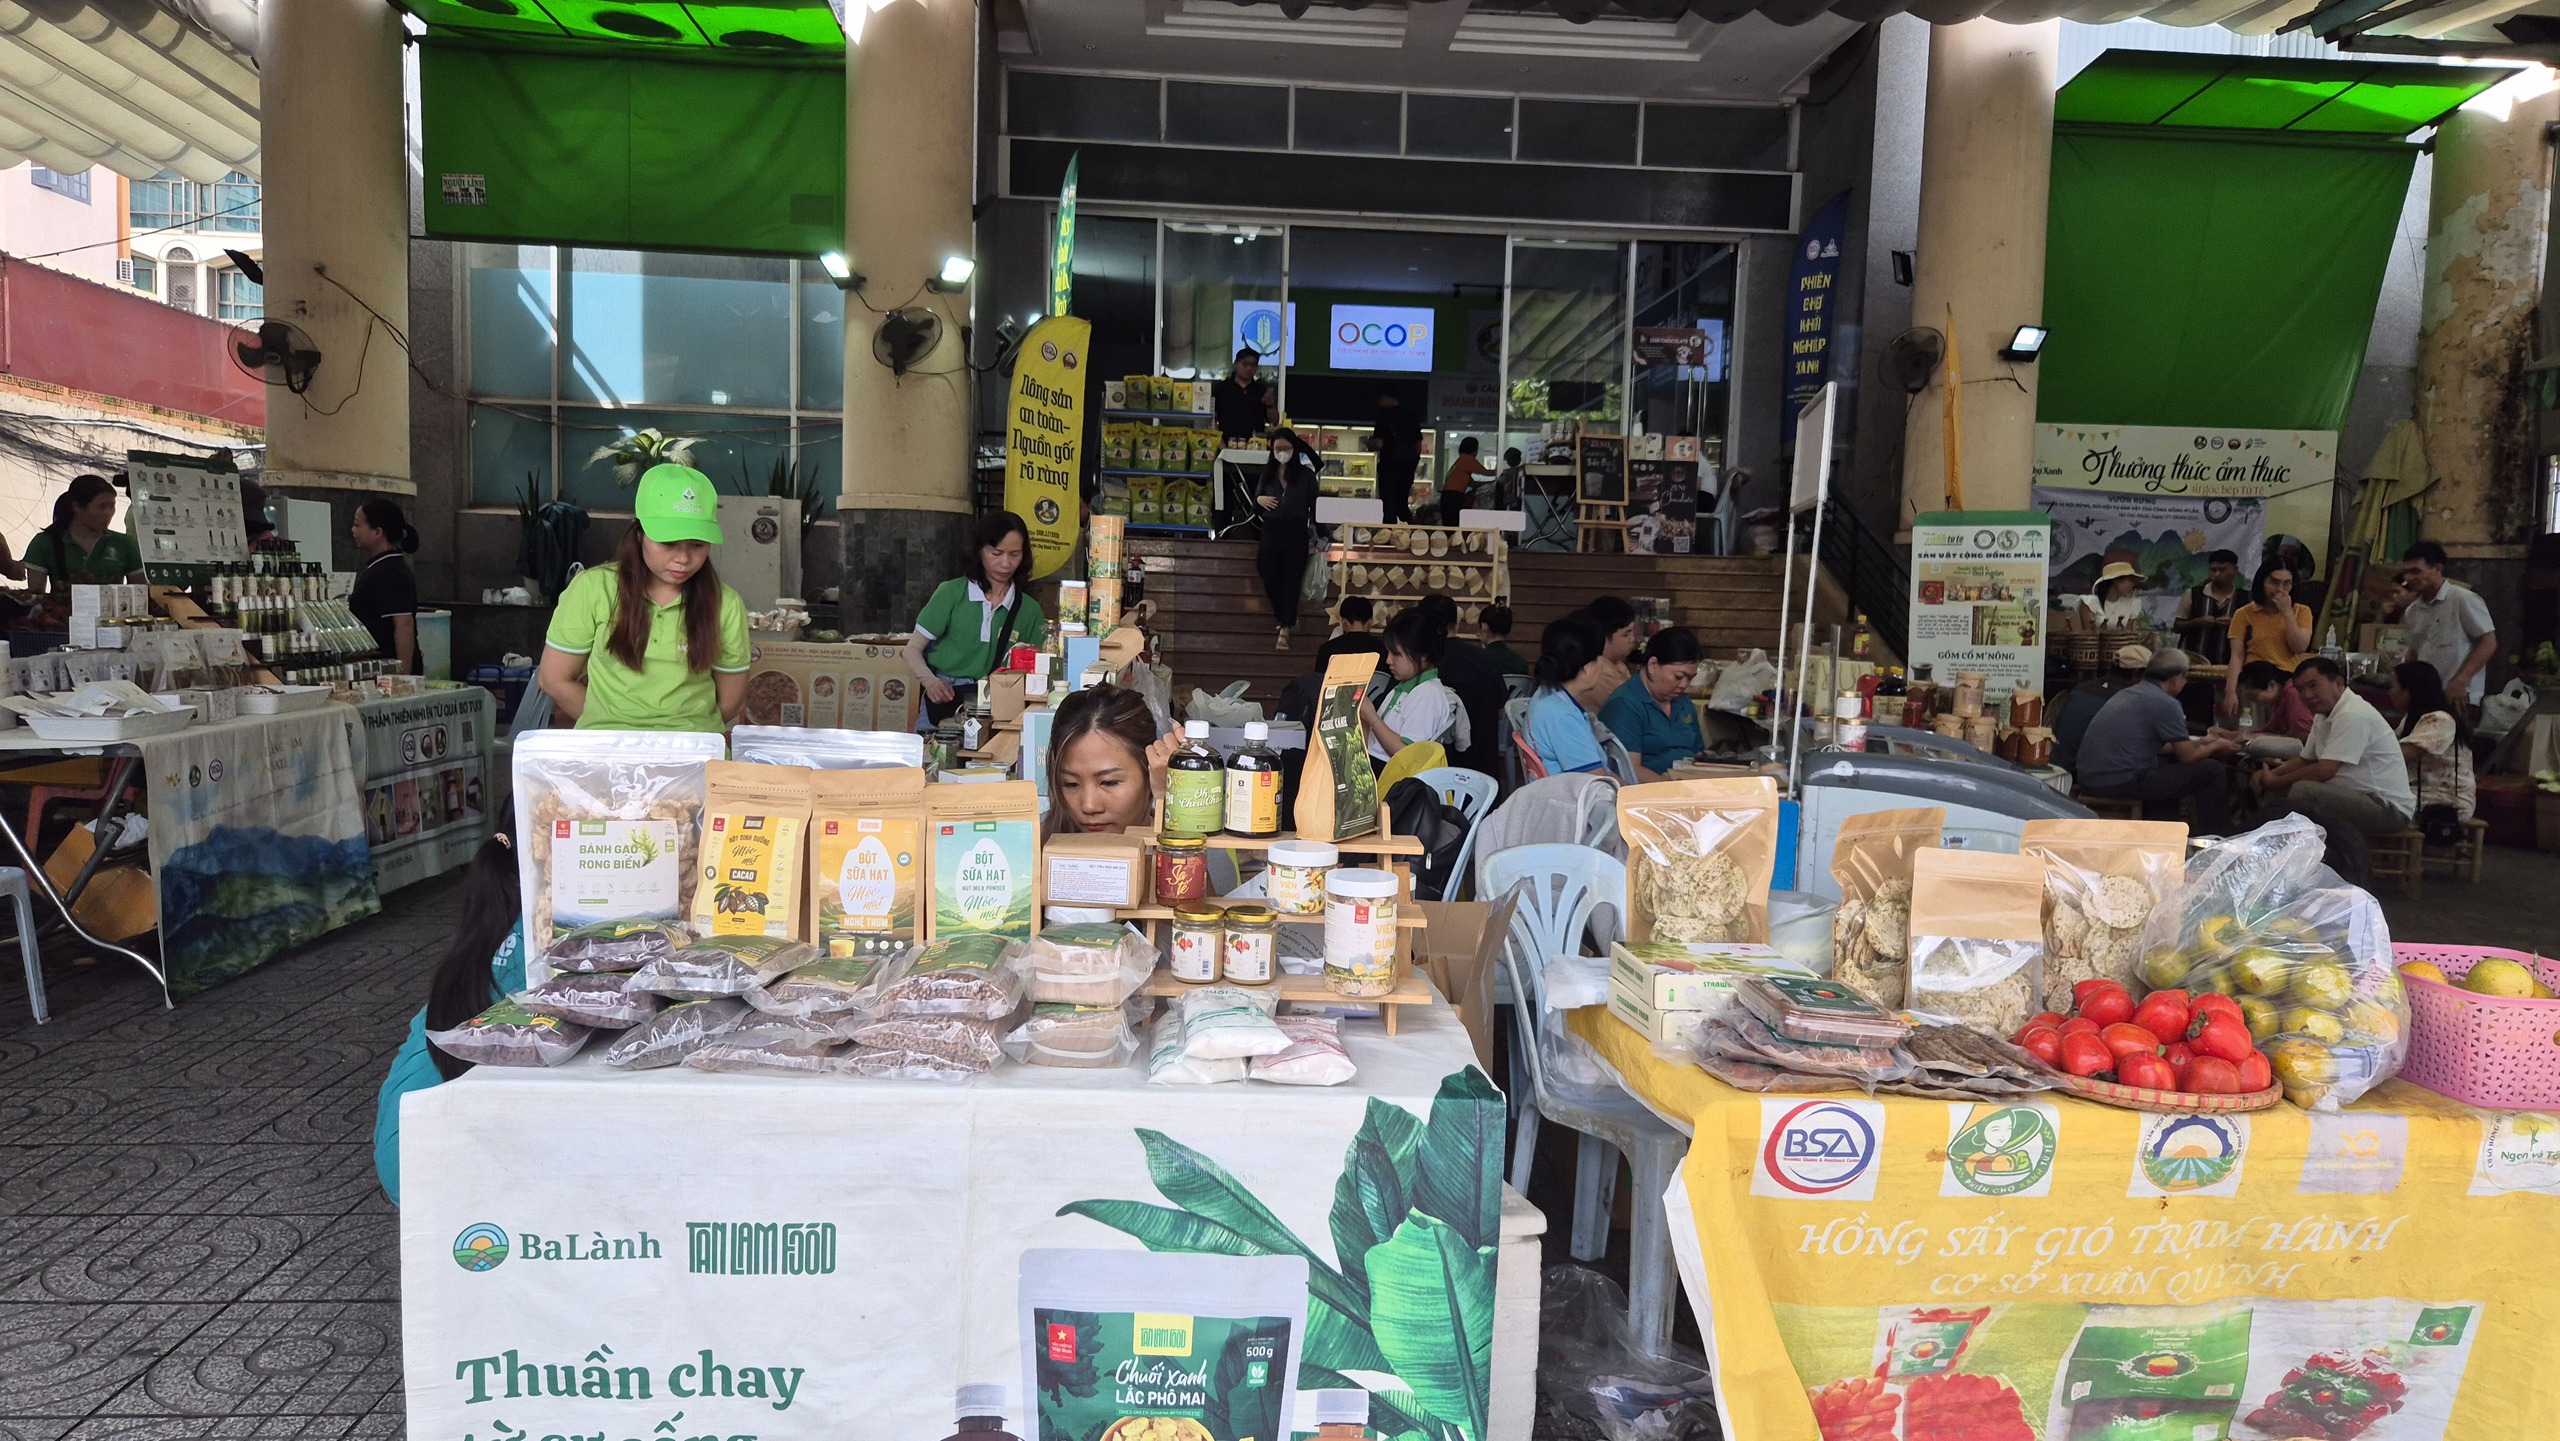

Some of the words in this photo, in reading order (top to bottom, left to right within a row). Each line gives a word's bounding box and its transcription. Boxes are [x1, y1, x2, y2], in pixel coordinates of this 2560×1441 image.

[1801, 271, 1832, 291] PHIÊN
[1803, 294, 1824, 314] CHỢ
[1338, 322, 1427, 348] OCOP
[1795, 359, 1819, 375] XANH
[1019, 373, 1050, 407] Nông
[1051, 388, 1073, 411] sản
[1019, 405, 1035, 426] an
[1012, 427, 1052, 459] Nguồn
[1019, 461, 1034, 480] rõ
[1037, 464, 1070, 491] ràng
[2043, 466, 2063, 475] Xanh
[2082, 445, 2188, 493] Thưởng
[2170, 452, 2210, 482] thức
[2215, 456, 2246, 482] ẩm
[2250, 455, 2291, 487] thực
[368, 709, 391, 729] PHẨM
[444, 701, 458, 716] QUẢ
[579, 842, 612, 854] BÁNH
[614, 845, 638, 857] GẠO
[858, 849, 878, 867] BỘT
[975, 850, 994, 867] BỘT
[579, 859, 611, 869] RONG
[613, 855, 641, 869] BIỂN
[731, 870, 755, 881] CACAO
[847, 866, 866, 880] SỮA
[870, 869, 889, 884] HẠT
[962, 867, 983, 881] SỮA
[986, 869, 1006, 884] HẠT
[1280, 880, 1297, 890] VIÊN
[963, 895, 997, 912] Mộc
[1280, 890, 1300, 900] GỪNG
[843, 915, 865, 929] NGHỆ
[866, 917, 889, 927] THƠM
[979, 905, 1006, 920] mát
[1784, 1128, 1860, 1158] BSA
[2501, 1151, 2529, 1163] Ngon
[1964, 1178, 1989, 1193] PHIÊN
[1992, 1185, 2016, 1194] CHỢ
[2018, 1168, 2044, 1189] XANH
[1797, 1209, 1929, 1264] HỒNG
[1938, 1211, 2027, 1259] SẤY
[2034, 1216, 2115, 1265] GIÓ
[2128, 1214, 2249, 1267] TRẠM
[2260, 1213, 2409, 1255] HÀNH
[1929, 1269, 1988, 1296] CƠ
[1995, 1257, 2047, 1296] SỞ
[2056, 1263, 2169, 1297] XUÂN
[456, 1343, 654, 1404] Thuần
[668, 1349, 805, 1410] chay
[1115, 1355, 1163, 1386] Chuối
[1115, 1386, 1145, 1405] LẮC
[1147, 1390, 1177, 1406] PHÔ
[1179, 1391, 1206, 1406] MAI
